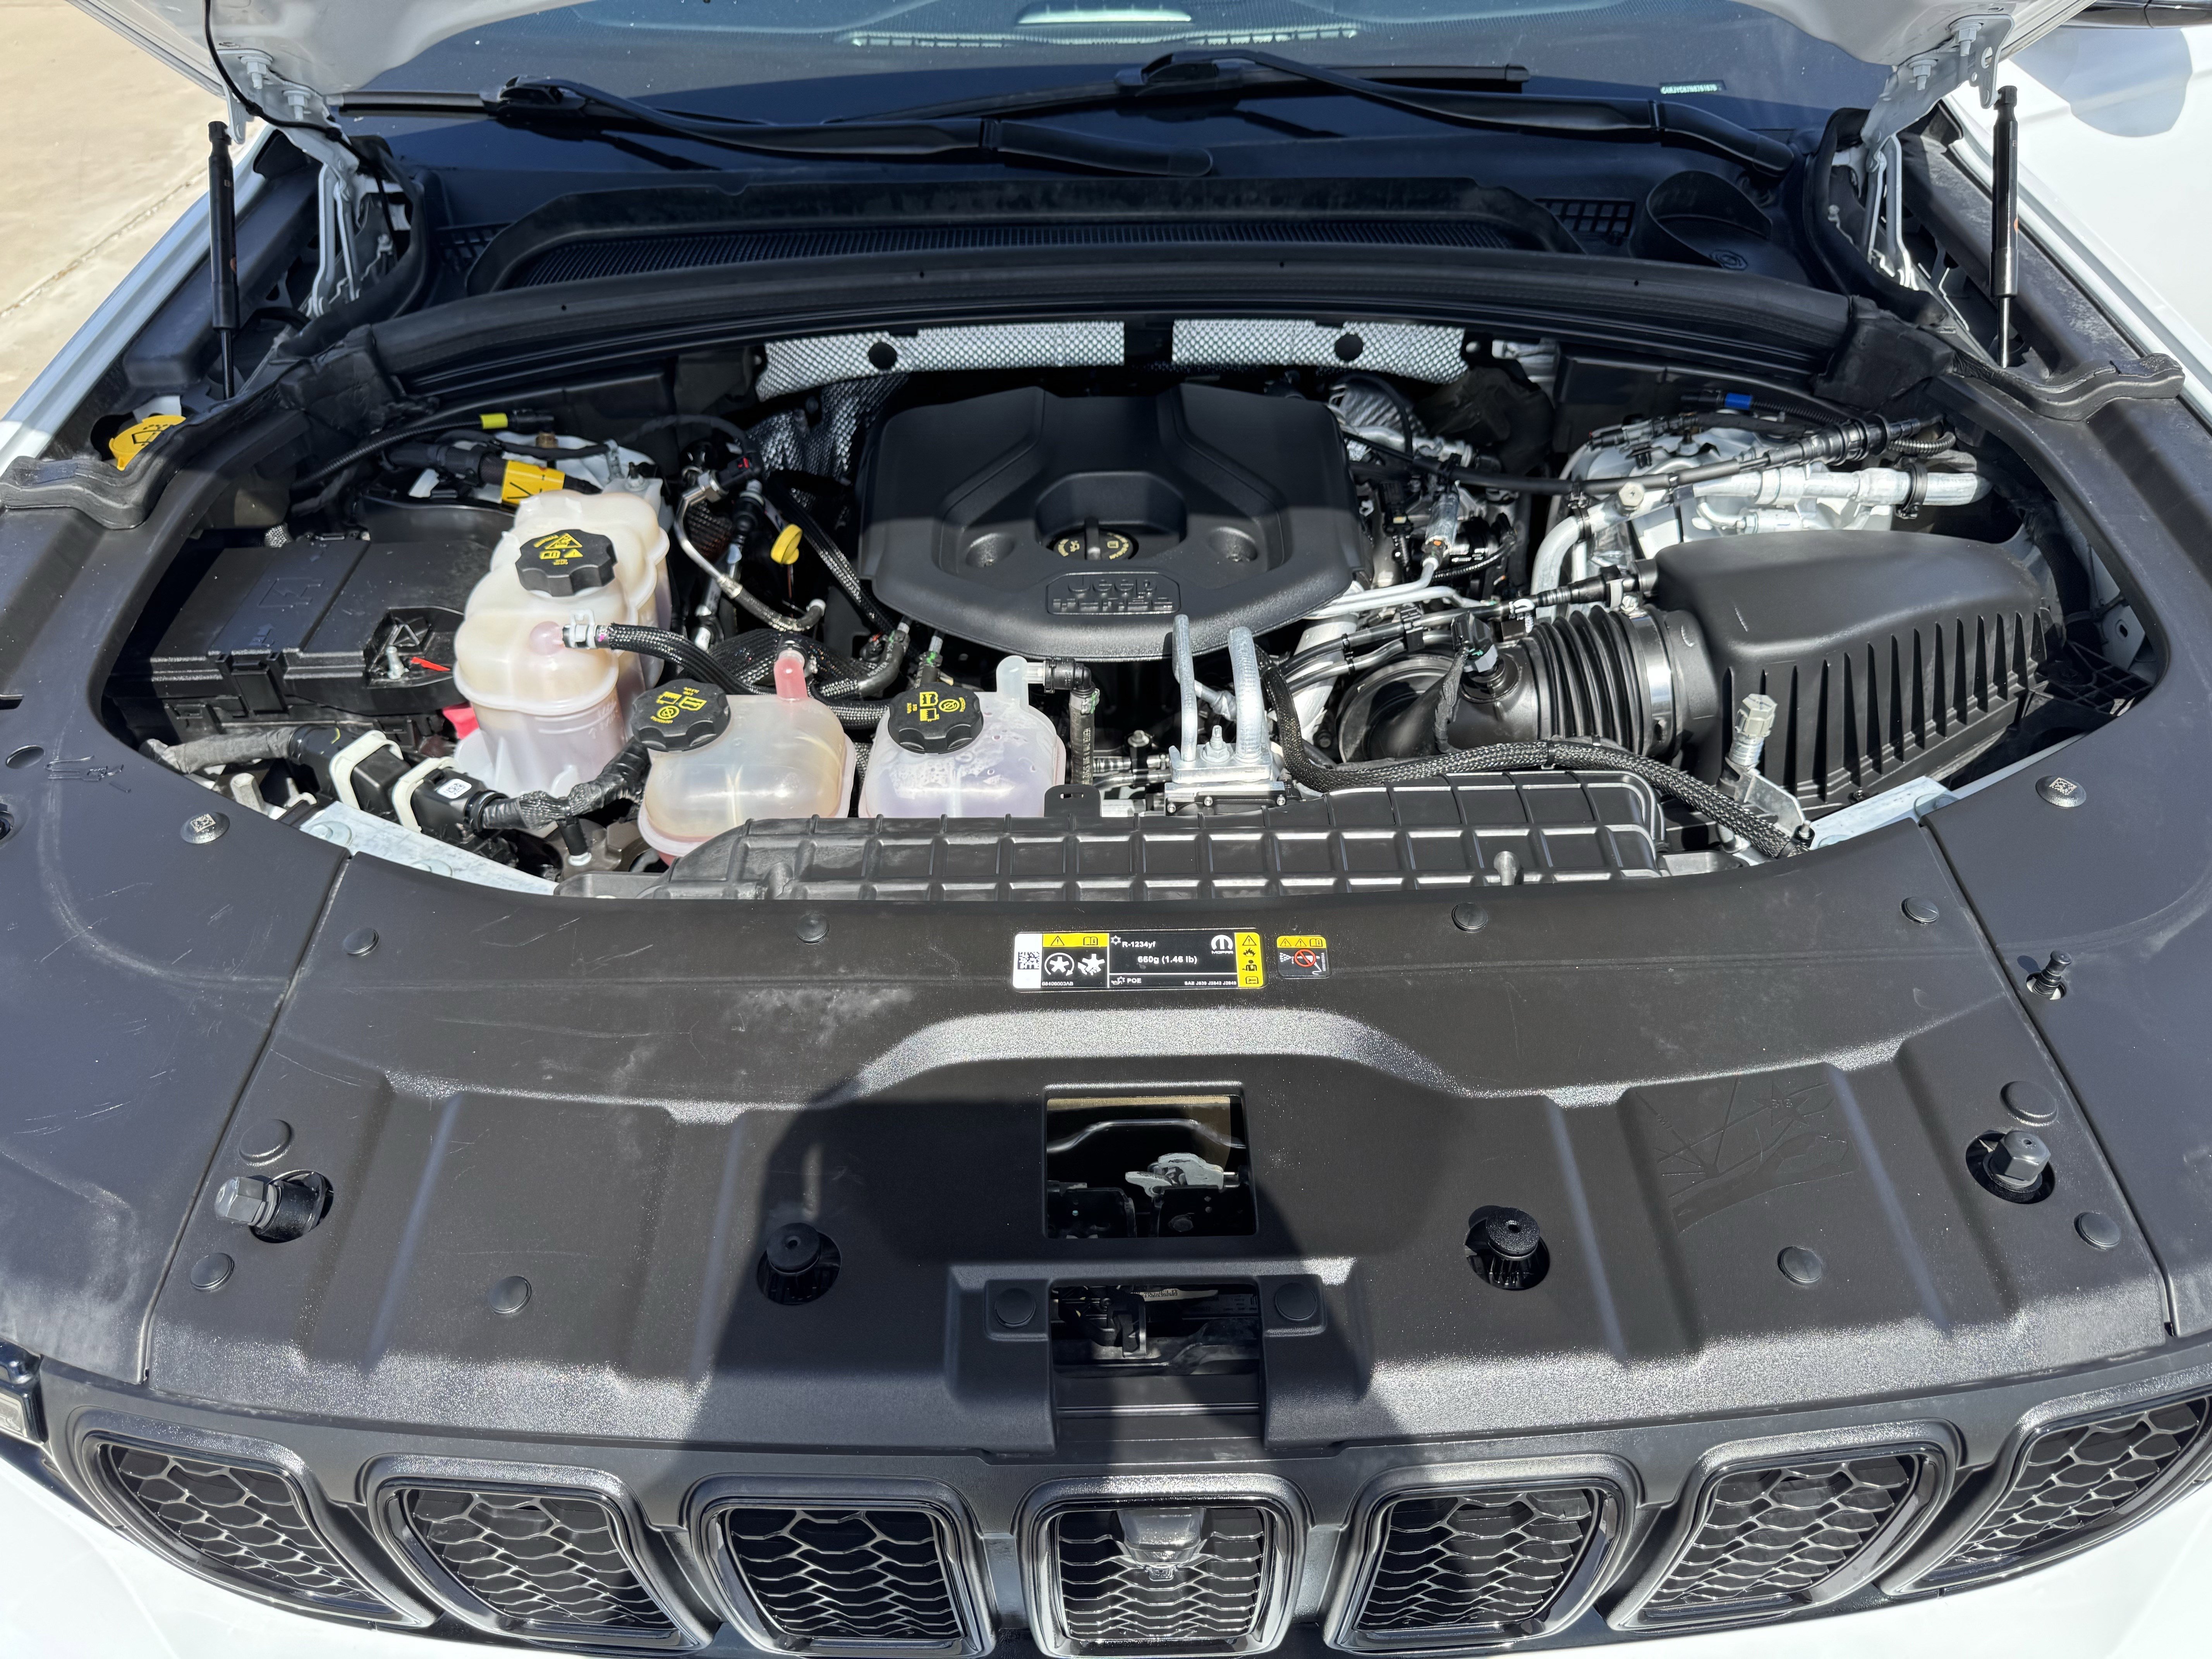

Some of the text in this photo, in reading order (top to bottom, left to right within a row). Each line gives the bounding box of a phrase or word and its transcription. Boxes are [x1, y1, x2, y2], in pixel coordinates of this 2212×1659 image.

[1068, 576, 1157, 598] Jeep
[1137, 956, 1197, 964] 660g (1.46 lb)
